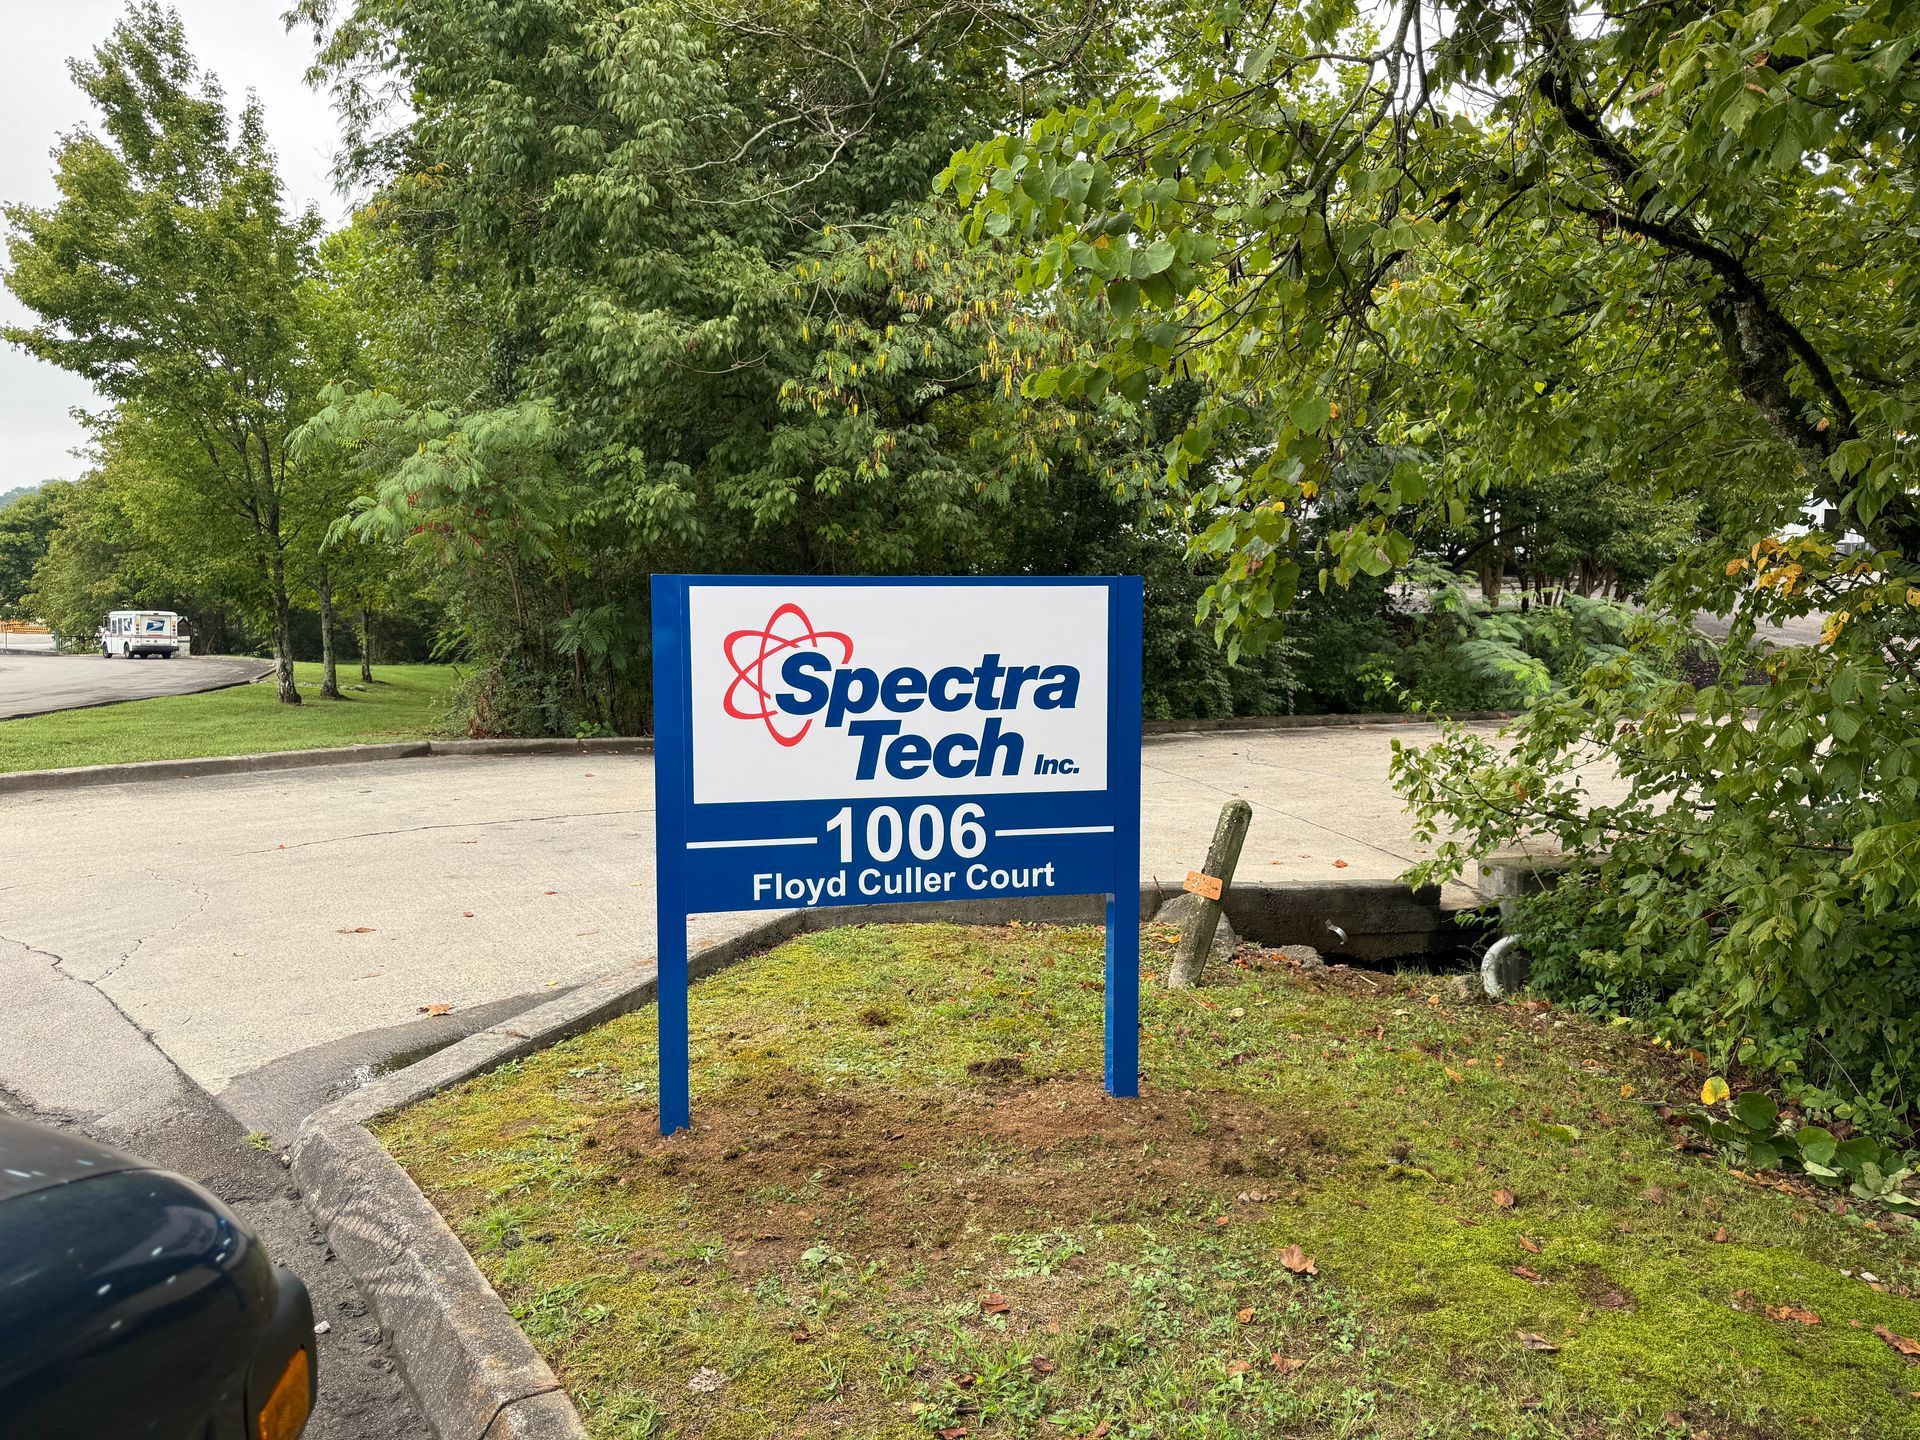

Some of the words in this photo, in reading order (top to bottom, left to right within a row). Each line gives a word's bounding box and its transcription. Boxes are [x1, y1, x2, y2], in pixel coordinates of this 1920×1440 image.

[776, 651, 1081, 728] Spectra
[848, 717, 1025, 781] Tech
[1034, 754, 1081, 775] Inc.
[826, 803, 987, 863] 1006
[753, 870, 847, 906] Floyd
[858, 867, 956, 896] Culler
[966, 862, 1055, 891] Court
